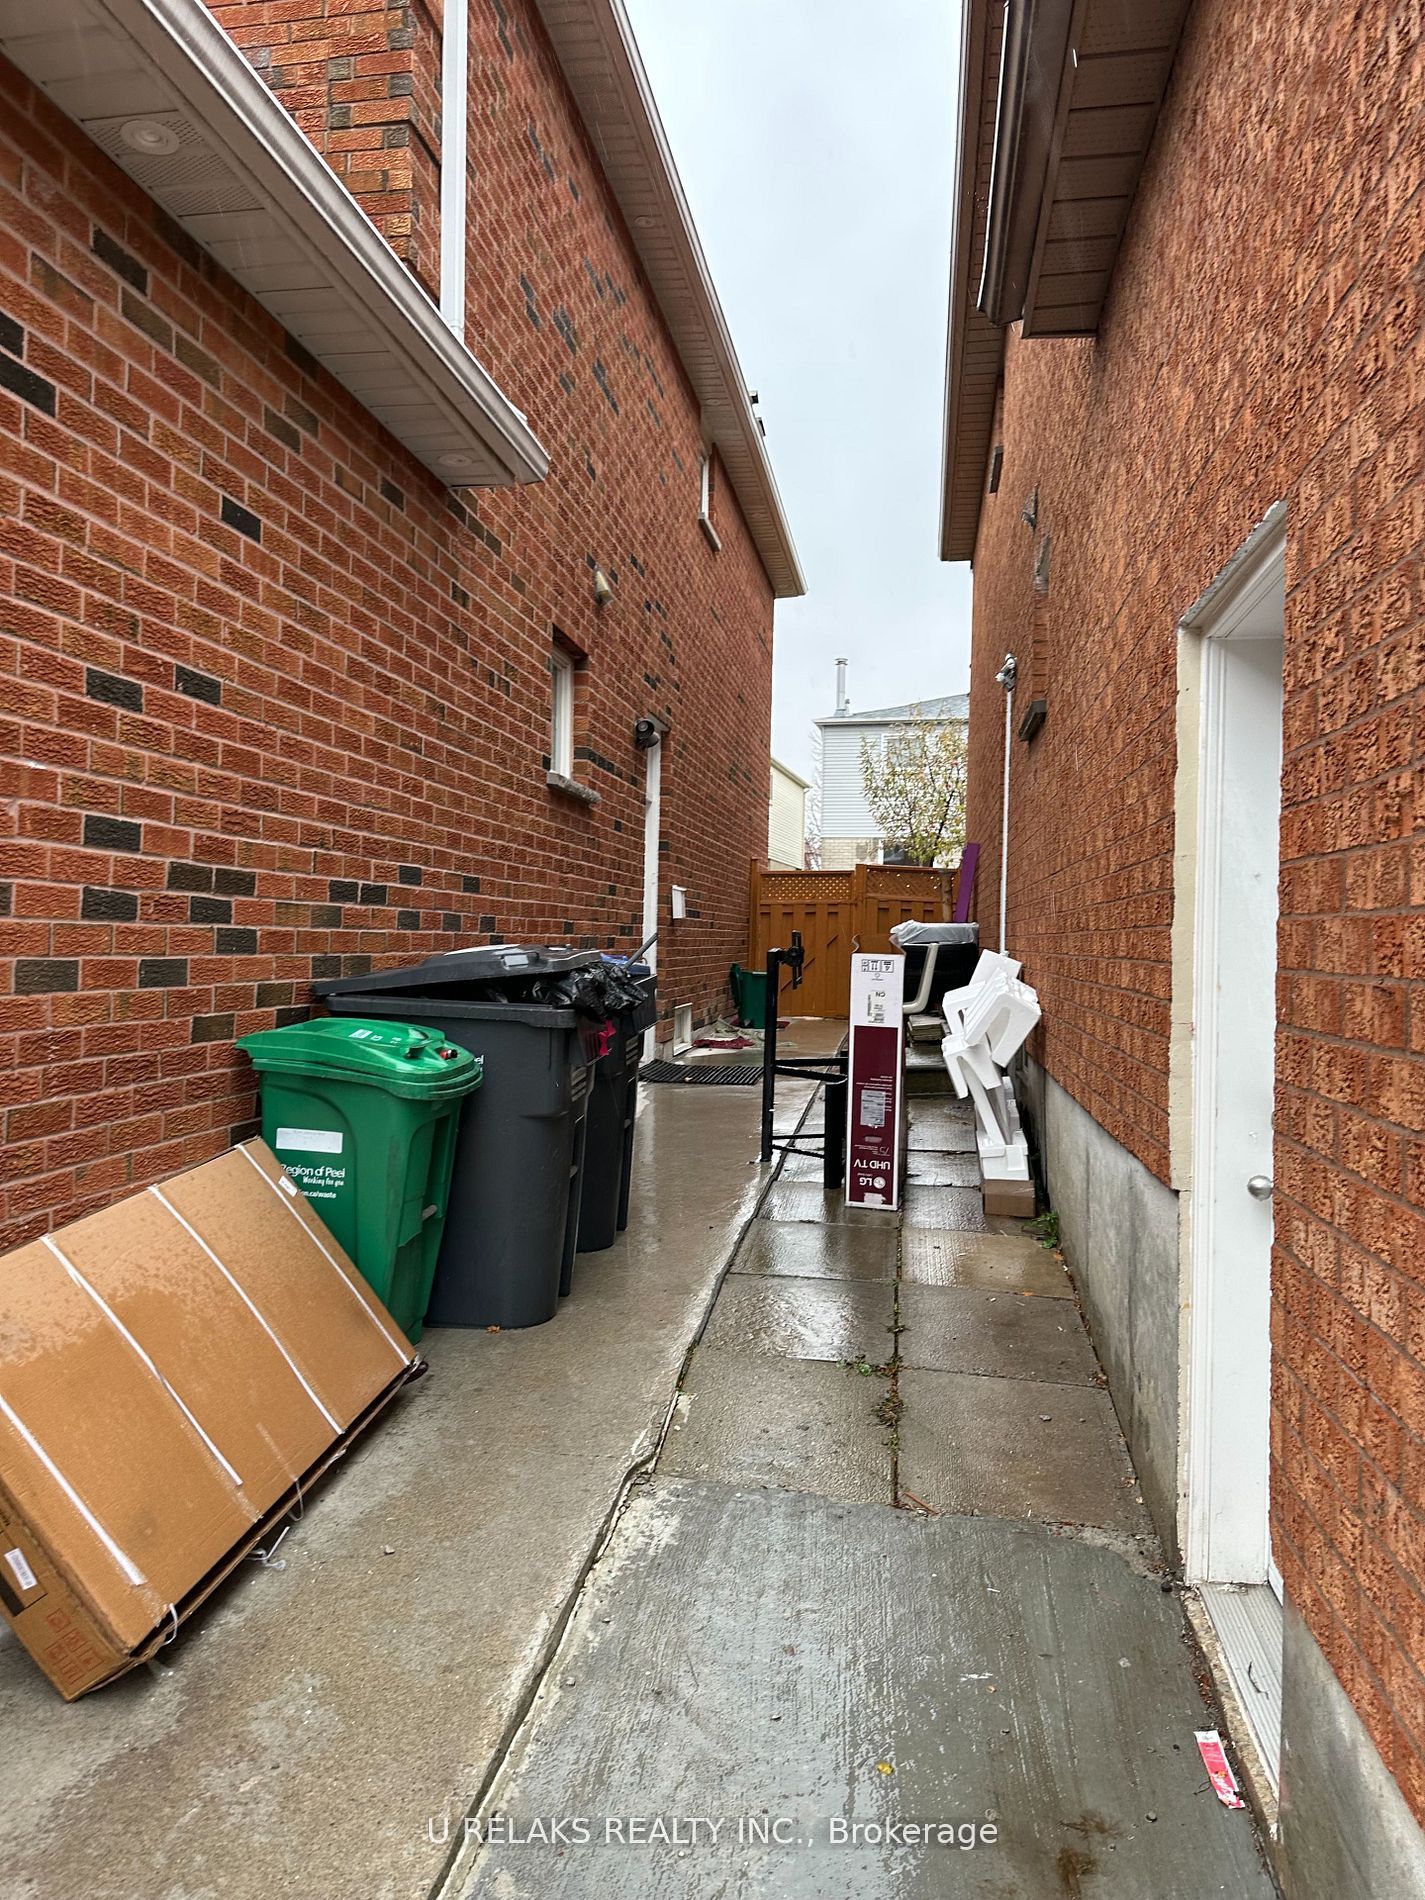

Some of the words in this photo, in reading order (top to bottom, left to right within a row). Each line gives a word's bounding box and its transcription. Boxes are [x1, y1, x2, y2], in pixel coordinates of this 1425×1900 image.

[853, 1158, 869, 1169] TV
[869, 1160, 891, 1170] UHD
[314, 1165, 325, 1176] of
[325, 1167, 345, 1178] Peel
[859, 1177, 873, 1187] LG
